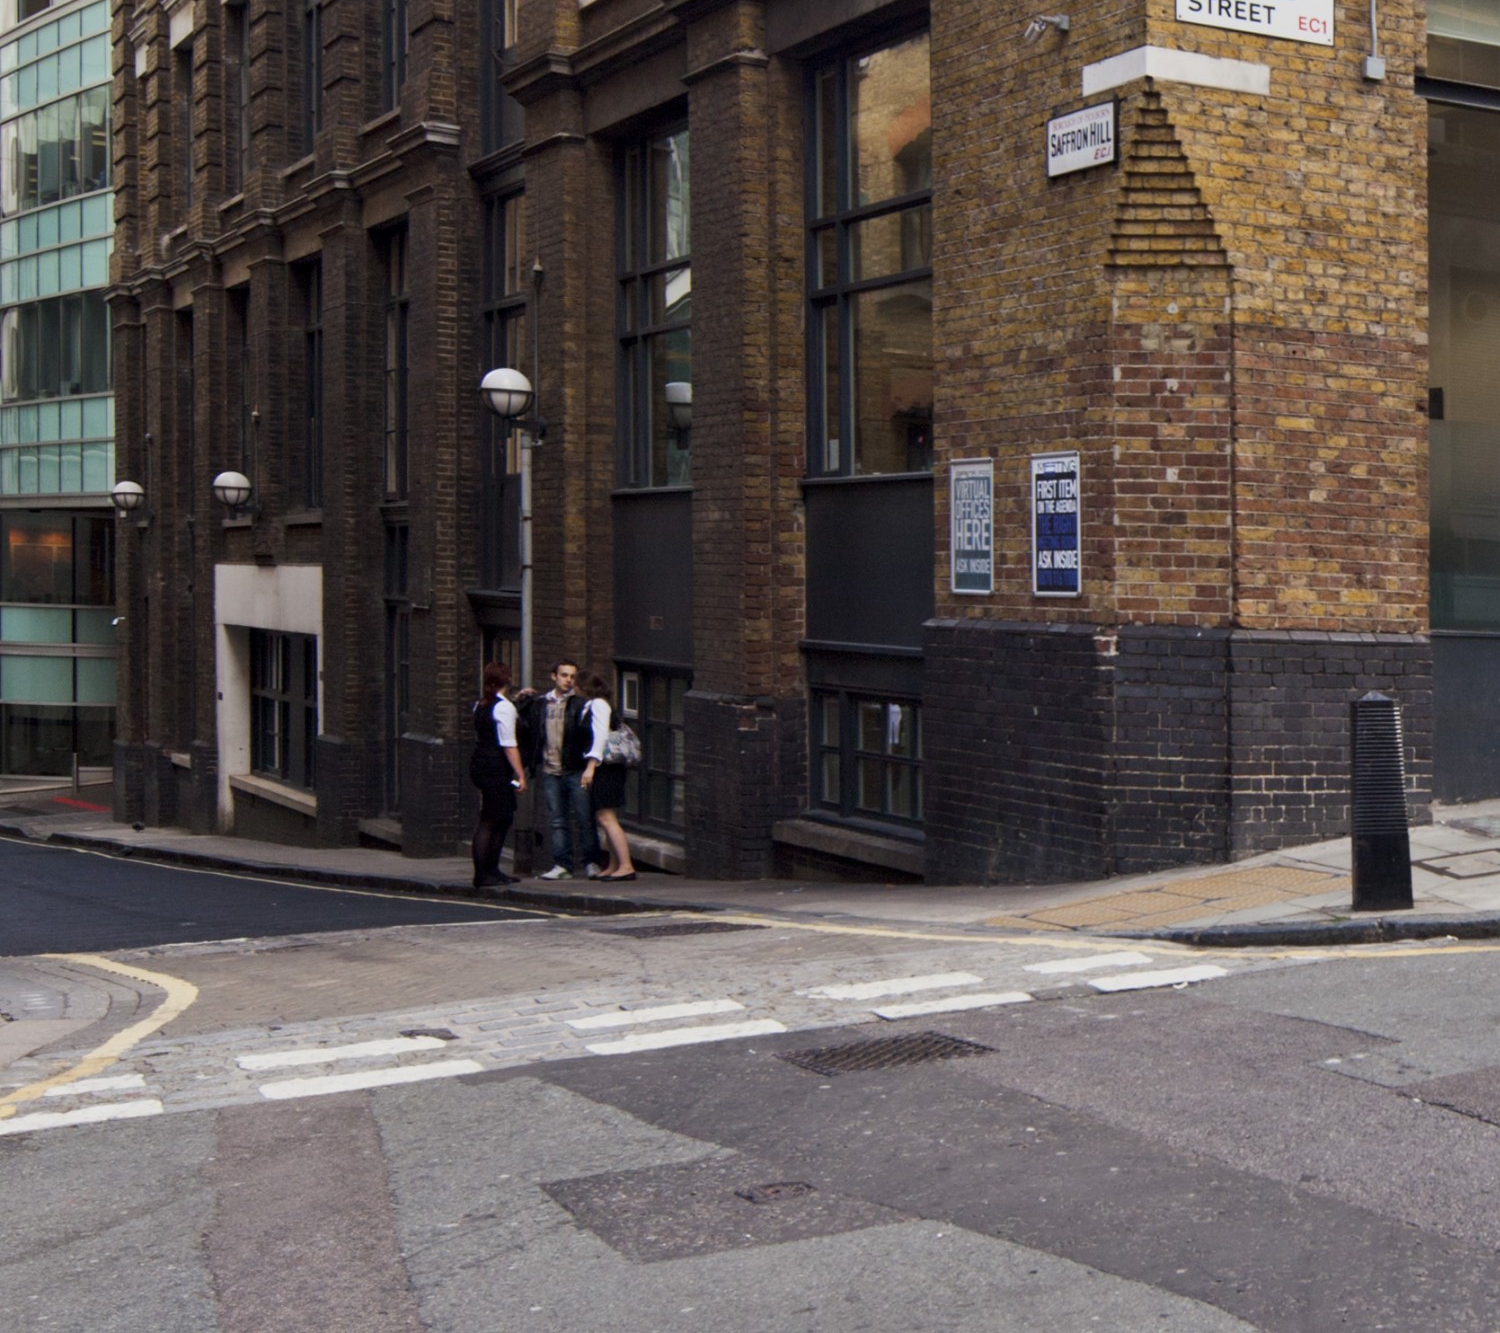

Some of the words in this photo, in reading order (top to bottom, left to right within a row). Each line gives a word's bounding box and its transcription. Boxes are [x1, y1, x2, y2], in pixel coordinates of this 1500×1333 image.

[1298, 16, 1327, 34] EC1
[1051, 126, 1088, 157] SAFFRON
[1090, 120, 1111, 147] HILL
[955, 479, 990, 500] VIRTUAL
[1037, 480, 1058, 499] FIRST
[1058, 479, 1077, 498] ITEM
[955, 500, 990, 519] OFFICES
[955, 519, 990, 550] HERE
[956, 560, 968, 574] ASK
[970, 559, 990, 574] INSIDE
[1038, 550, 1053, 569] ASK
[1054, 550, 1078, 569] INSIDE
